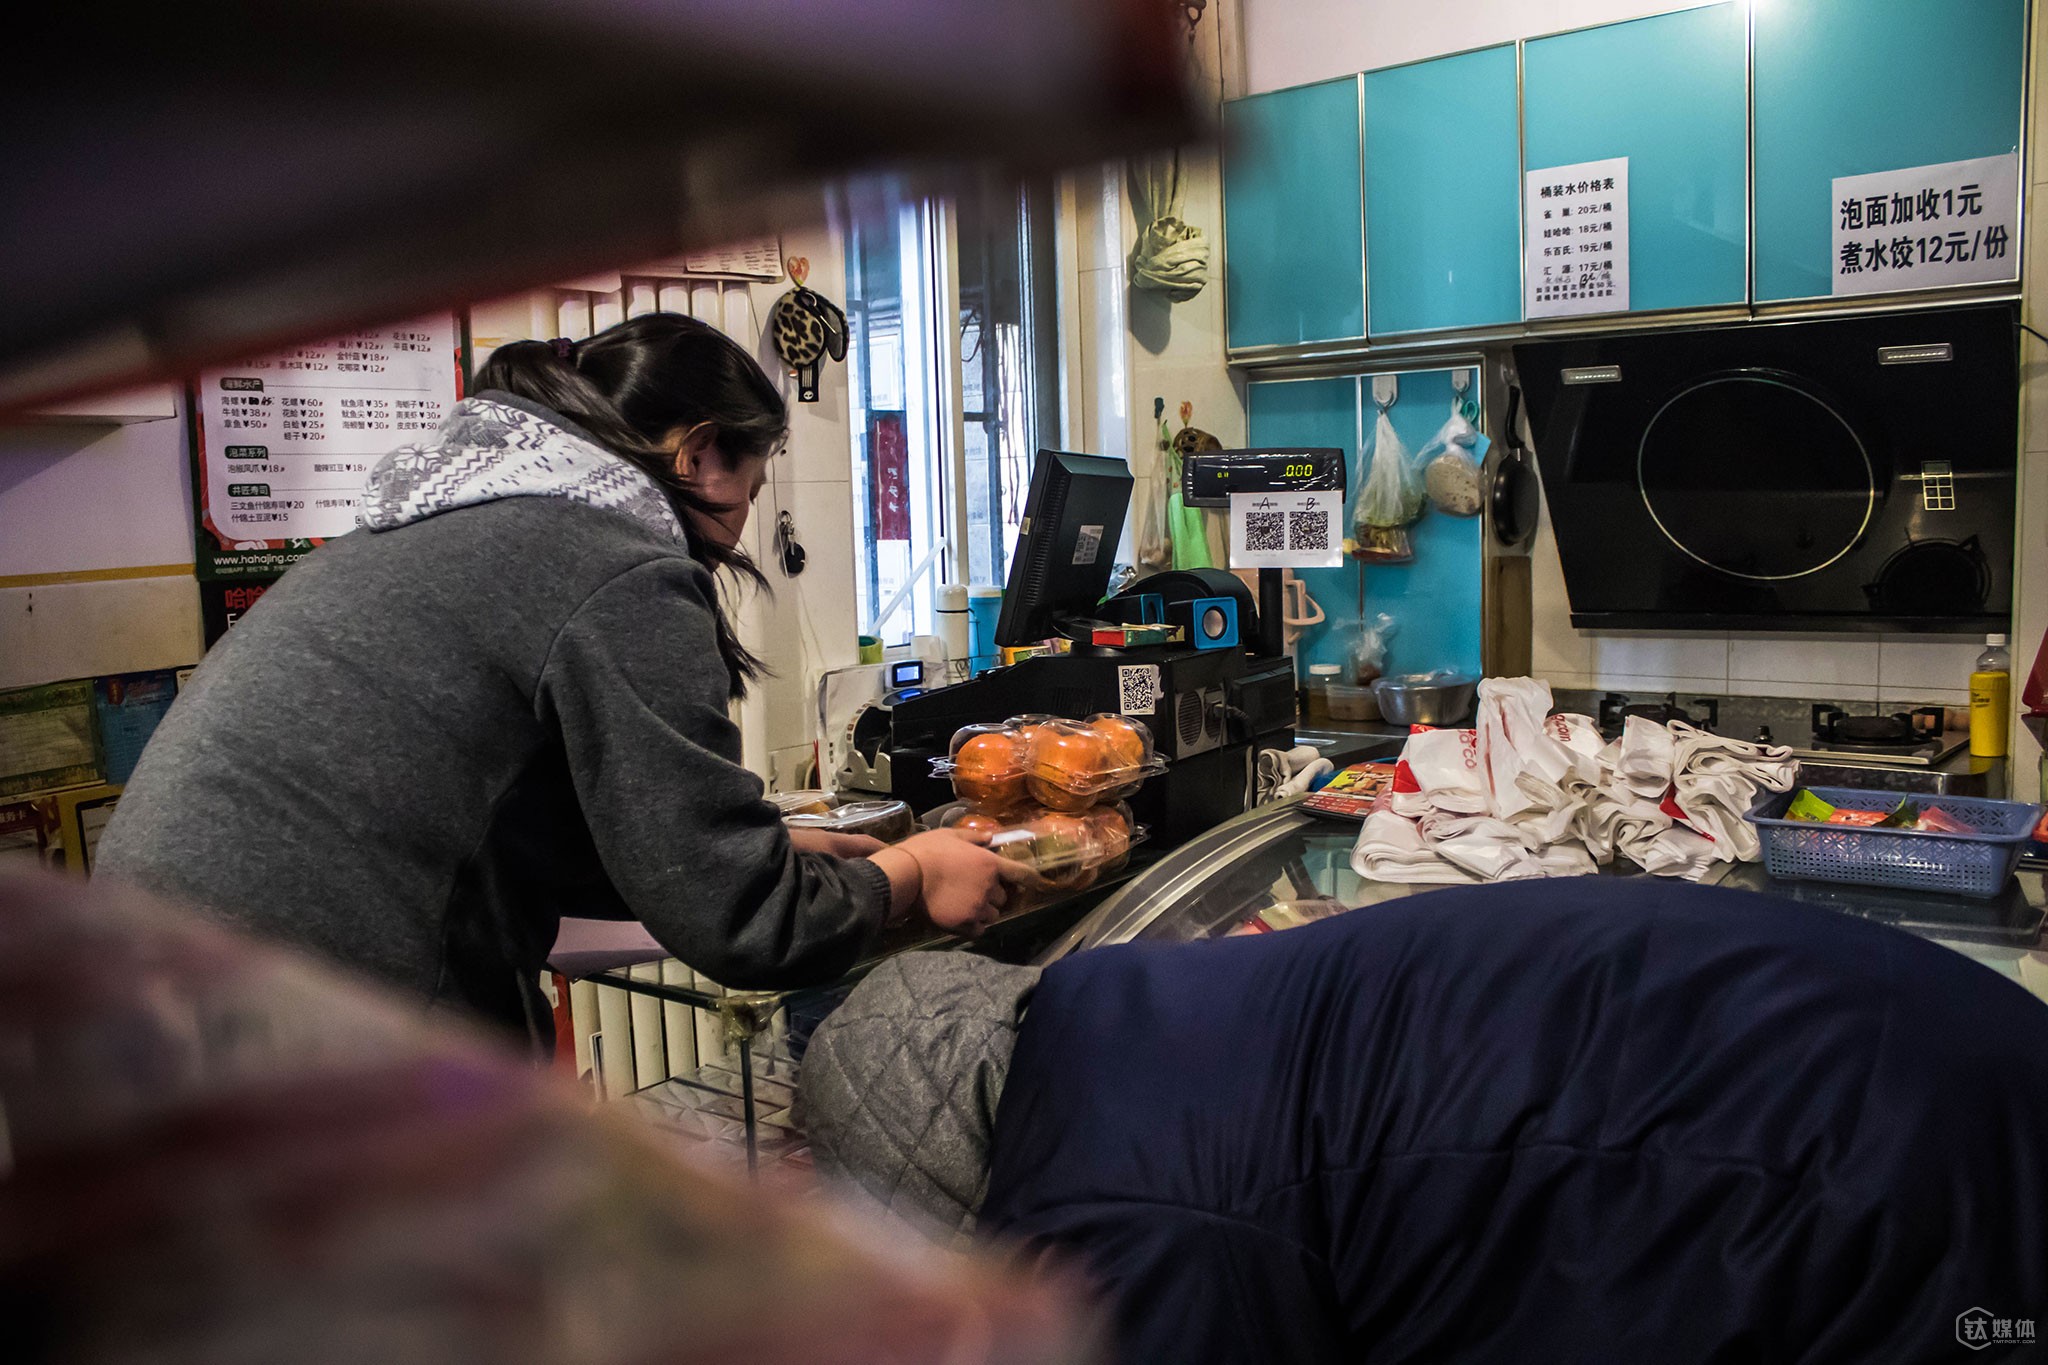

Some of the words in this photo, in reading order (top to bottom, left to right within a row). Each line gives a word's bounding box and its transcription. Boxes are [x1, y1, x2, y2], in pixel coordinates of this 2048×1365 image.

[1540, 177, 1615, 198] 桶装水价格表
[1840, 184, 1983, 231] 泡面加收1元
[1840, 224, 2009, 274] 煮水饺12元/份
[229, 447, 266, 458] 泡菜系列
[1259, 496, 1271, 510] A
[1306, 496, 1316, 510] B
